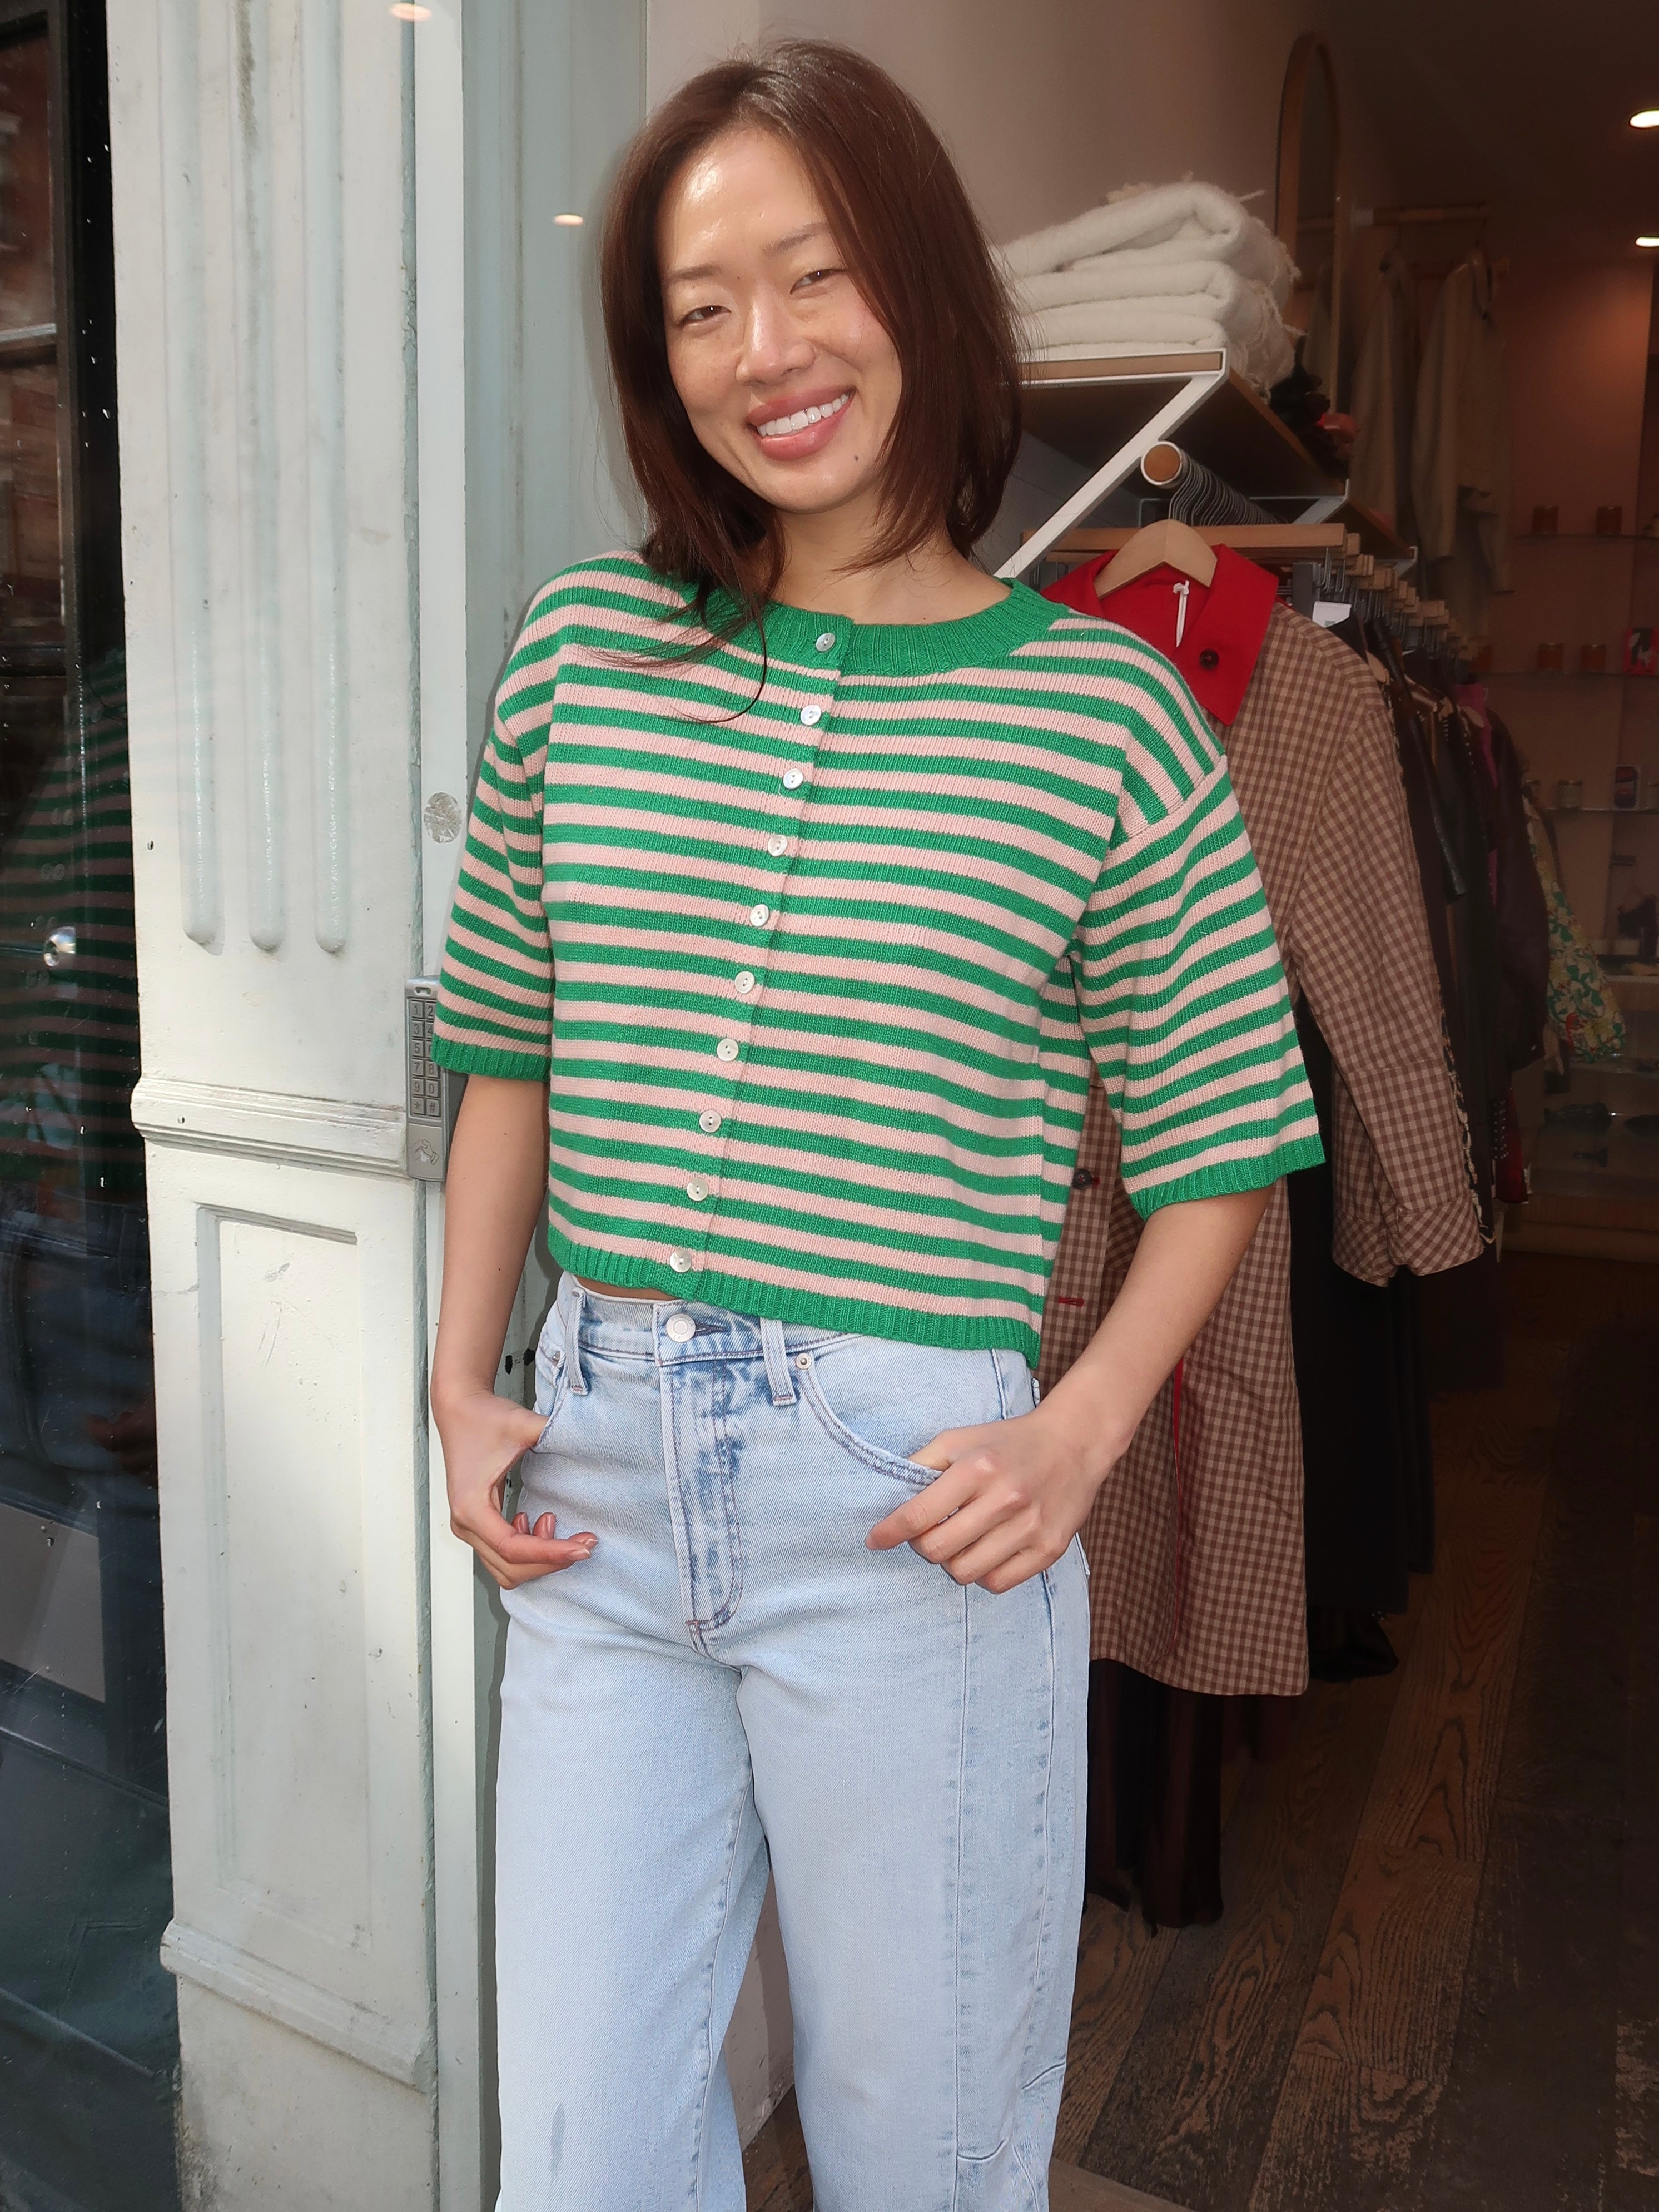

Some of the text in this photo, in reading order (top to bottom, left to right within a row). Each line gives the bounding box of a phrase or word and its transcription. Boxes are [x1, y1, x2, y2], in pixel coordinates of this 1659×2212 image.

[427, 1005, 434, 1016] 2
[413, 1023, 434, 1035] 3 4
[414, 1043, 420, 1054] 5
[414, 1062, 435, 1075] 7 8
[414, 1081, 435, 1094] 9 0
